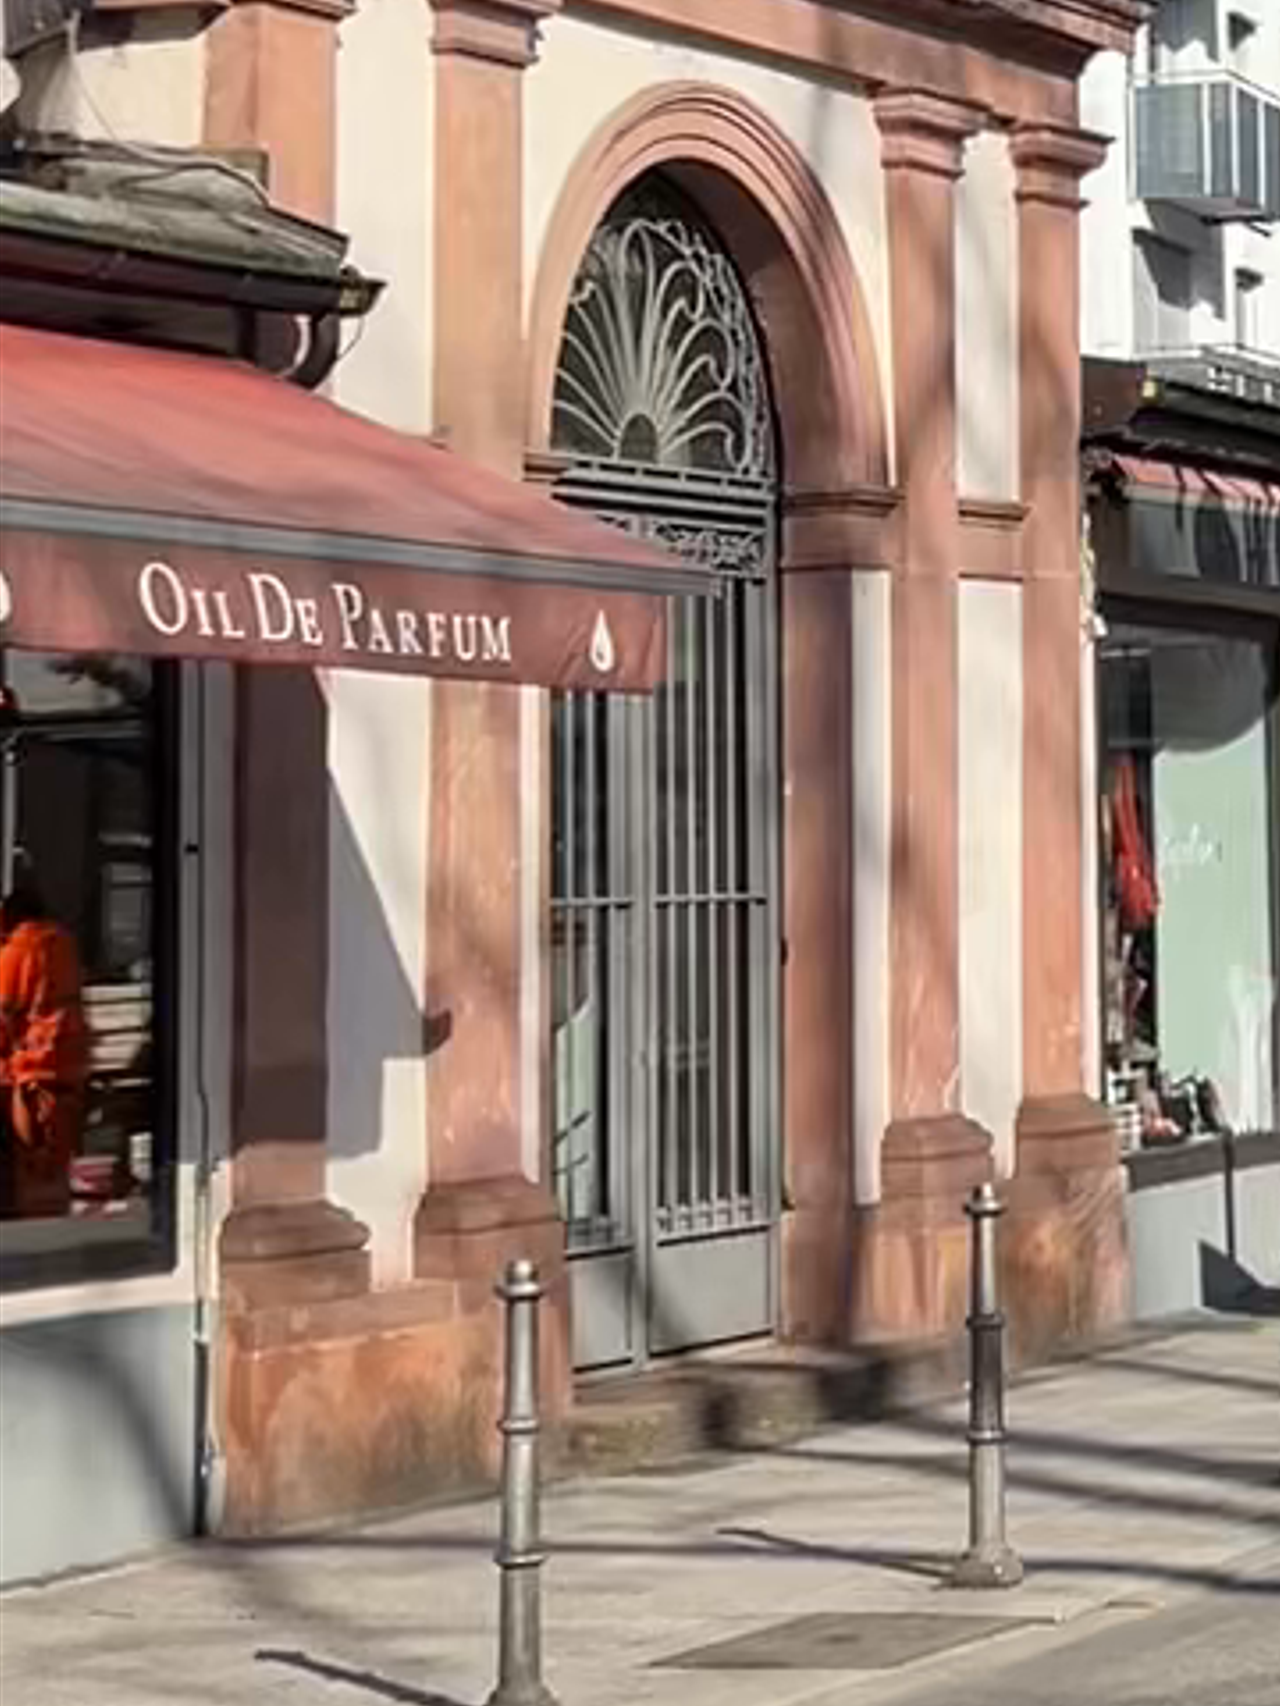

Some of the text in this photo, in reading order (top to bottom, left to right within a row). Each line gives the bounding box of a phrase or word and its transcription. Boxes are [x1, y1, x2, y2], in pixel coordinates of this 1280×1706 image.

[139, 561, 512, 663] OIL DE PARFUM
